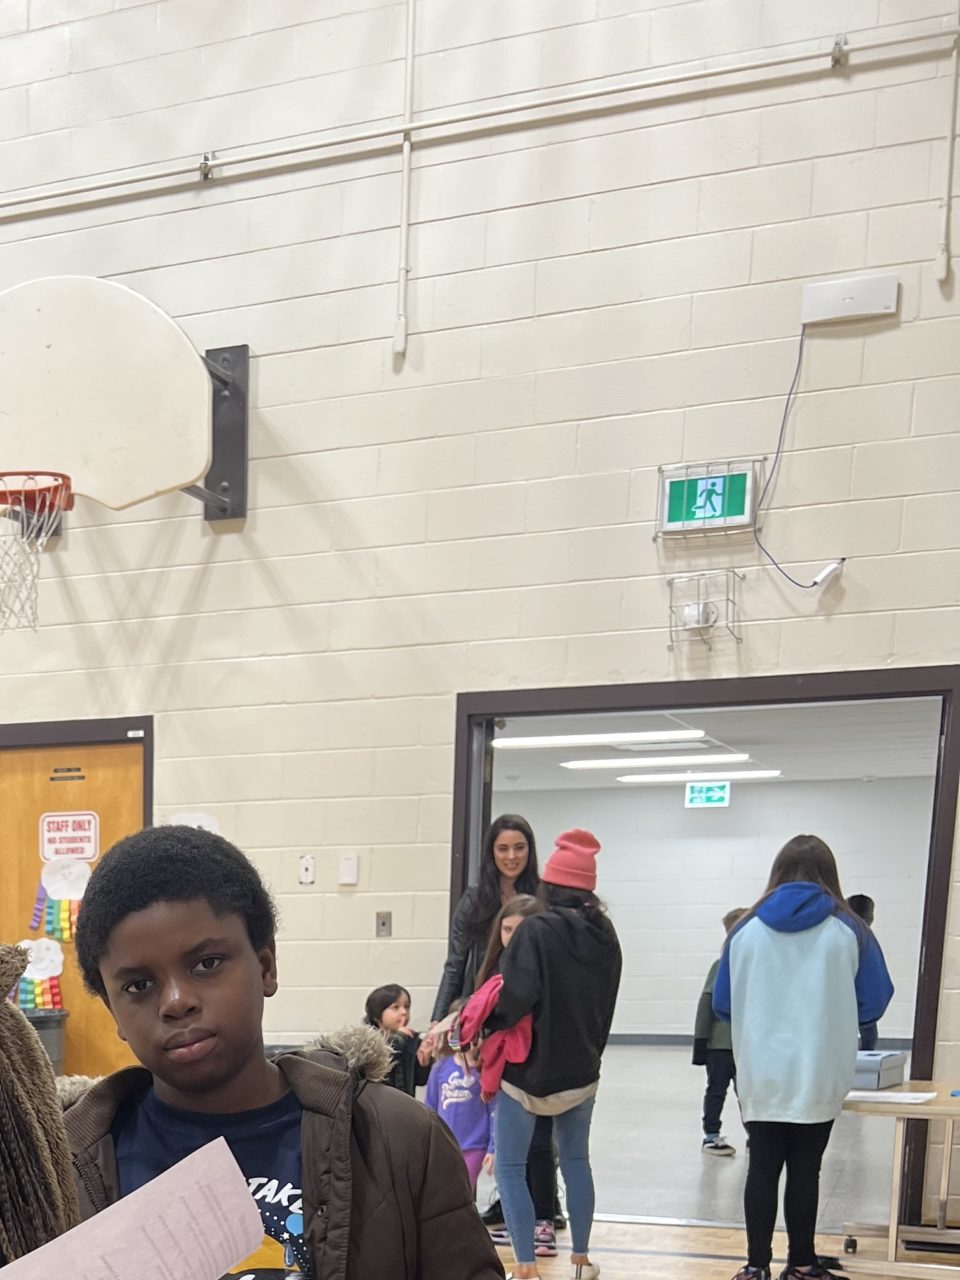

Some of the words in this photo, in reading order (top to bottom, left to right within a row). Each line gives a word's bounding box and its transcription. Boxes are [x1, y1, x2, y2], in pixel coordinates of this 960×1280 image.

[46, 820, 70, 833] STAFF
[72, 818, 92, 832] ONLY
[47, 836, 57, 845] NO
[58, 835, 92, 845] STUDENTS
[54, 846, 85, 856] ALLOWED
